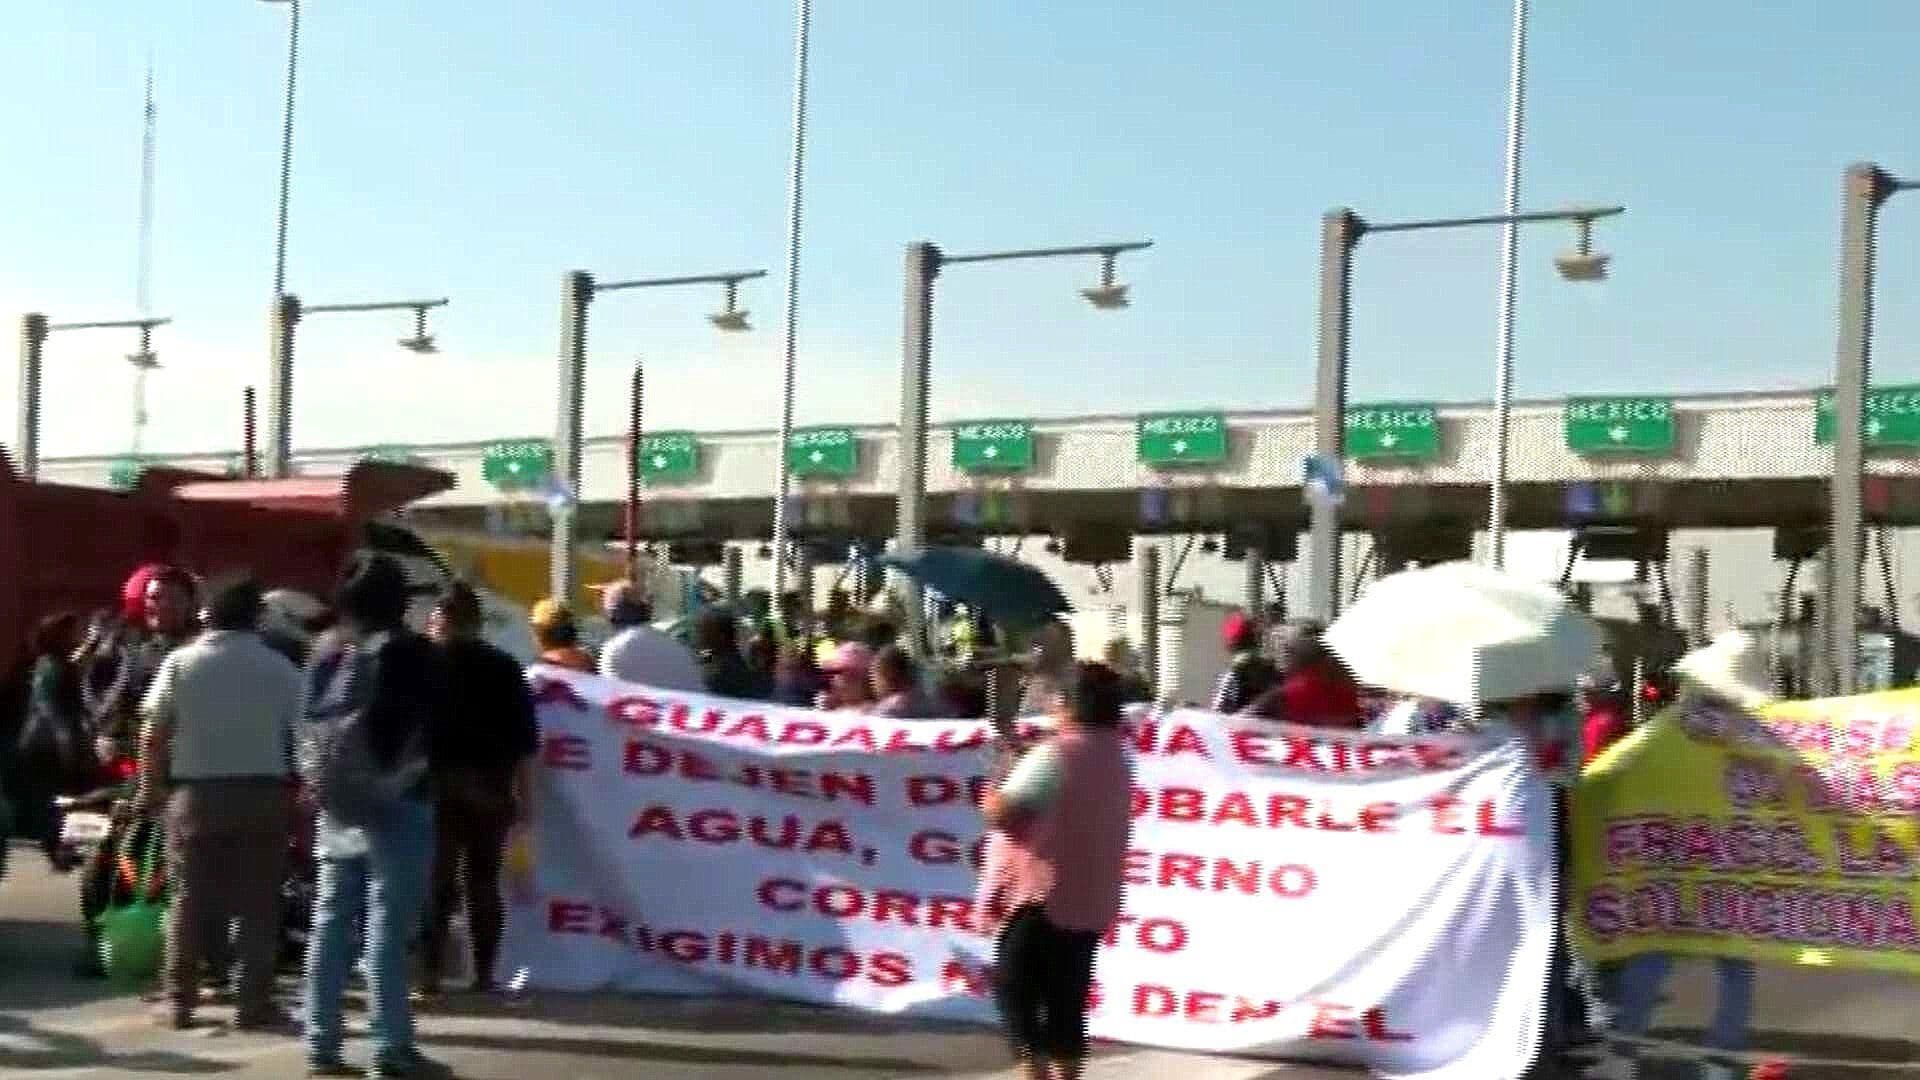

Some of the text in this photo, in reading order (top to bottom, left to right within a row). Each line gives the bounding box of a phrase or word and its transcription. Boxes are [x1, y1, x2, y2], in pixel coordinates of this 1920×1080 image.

[1143, 416, 1217, 433] MEXICO
[1345, 408, 1432, 429] MEXICO
[1568, 400, 1667, 421] MEXICO
[622, 739, 877, 806] DEJEN
[1426, 791, 1527, 838] EL
[627, 806, 879, 867] AGUA,
[548, 896, 914, 987] EXIGIMOS
[1310, 1002, 1418, 1043] EL
